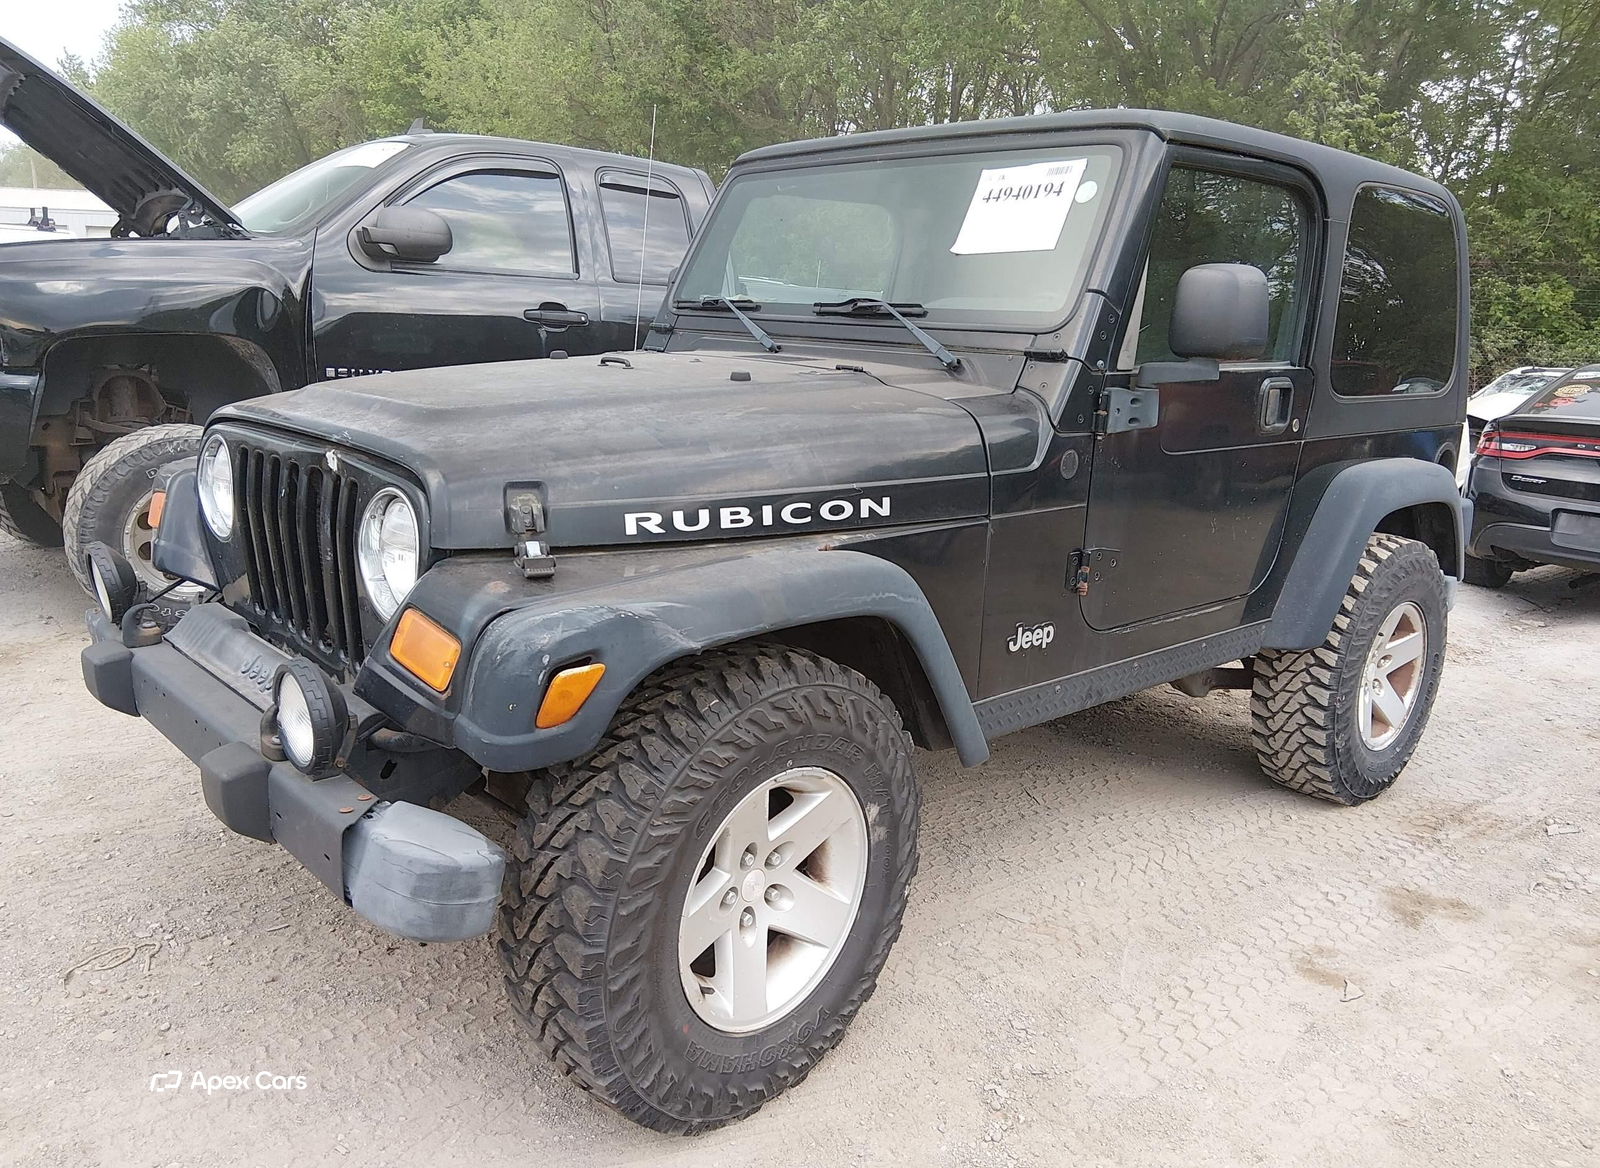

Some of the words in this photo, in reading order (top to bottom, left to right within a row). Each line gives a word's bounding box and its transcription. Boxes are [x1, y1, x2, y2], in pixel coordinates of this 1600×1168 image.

[982, 181, 1065, 204] 44940194
[624, 496, 891, 537] RUBICON
[1008, 624, 1056, 652] Jeep
[684, 1004, 831, 1075] YOKOHAMA
